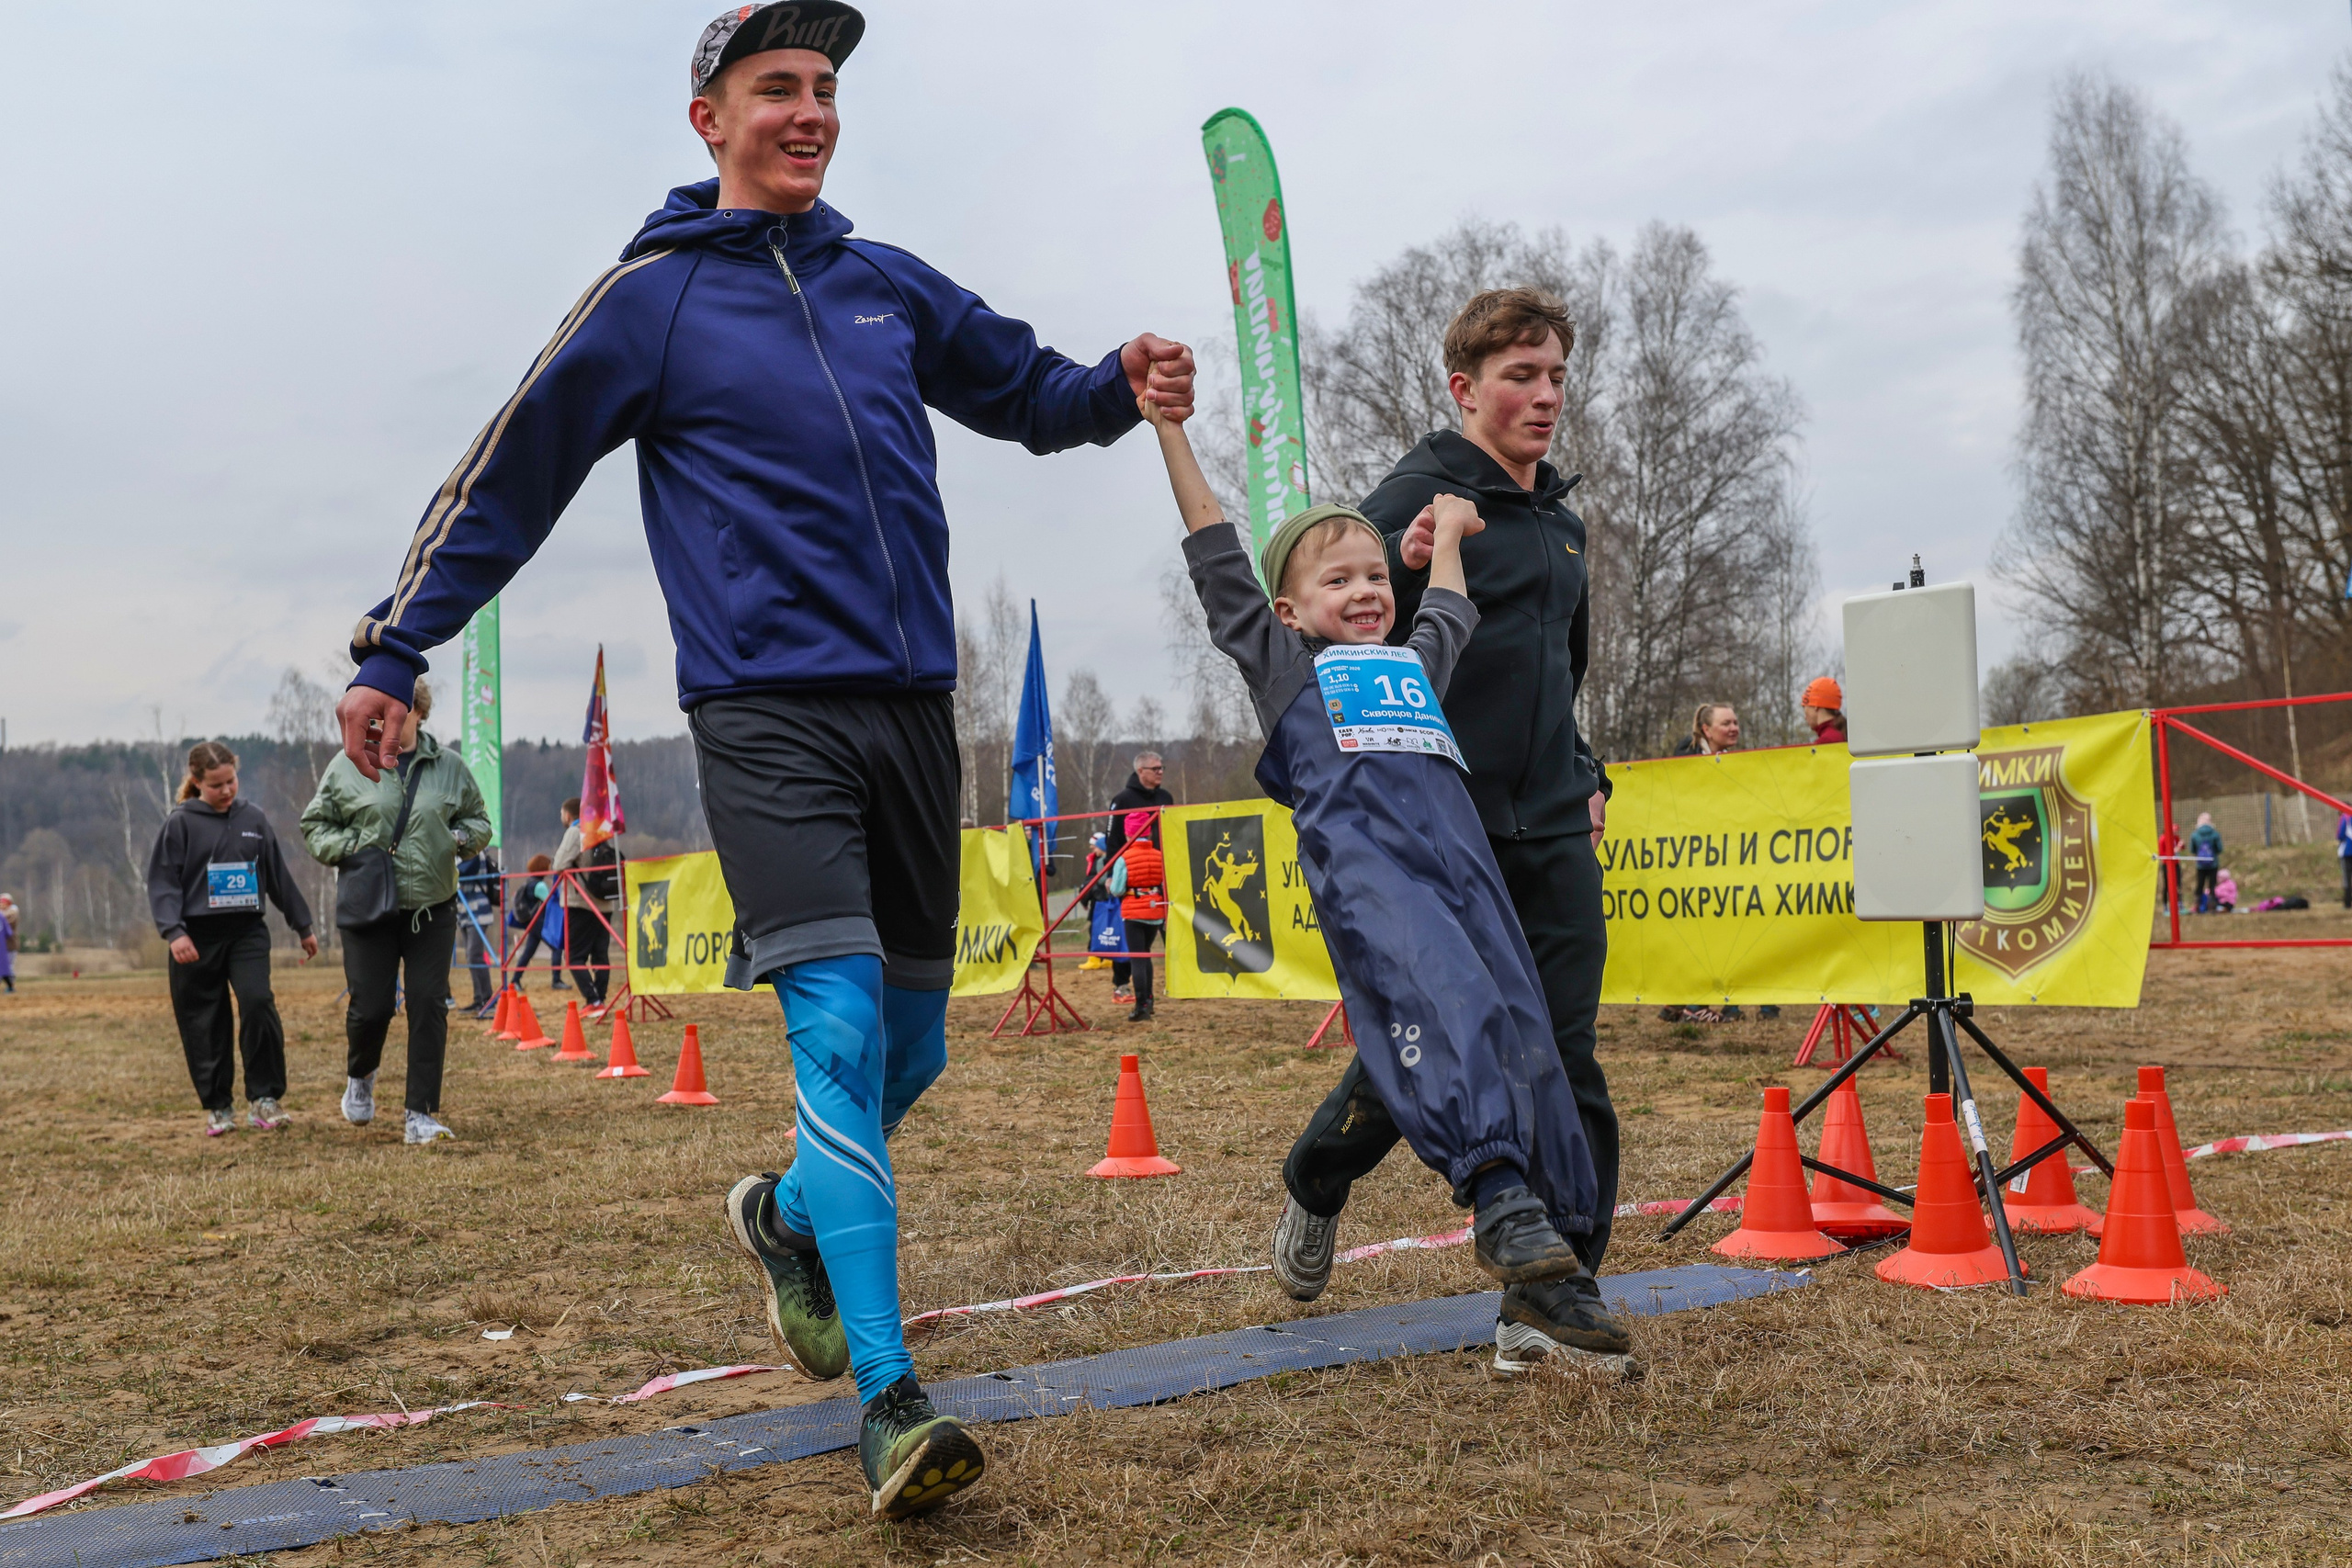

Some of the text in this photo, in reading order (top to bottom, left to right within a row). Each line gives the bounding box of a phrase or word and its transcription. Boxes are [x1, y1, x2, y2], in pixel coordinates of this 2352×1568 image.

[1323, 649, 1408, 660] ХИМКИНСКИЙ ЛЕС
[1328, 672, 1350, 684] 1,10
[1374, 674, 1427, 708] 16
[1361, 709, 1413, 719] Скворцов
[1602, 833, 1728, 872] УЛЬТУРЫ
[1739, 831, 1758, 865] И
[226, 874, 246, 889] 29
[1603, 887, 1649, 920] ОГО
[1657, 885, 1766, 920] ОКРУГА
[1293, 903, 1320, 933] АД
